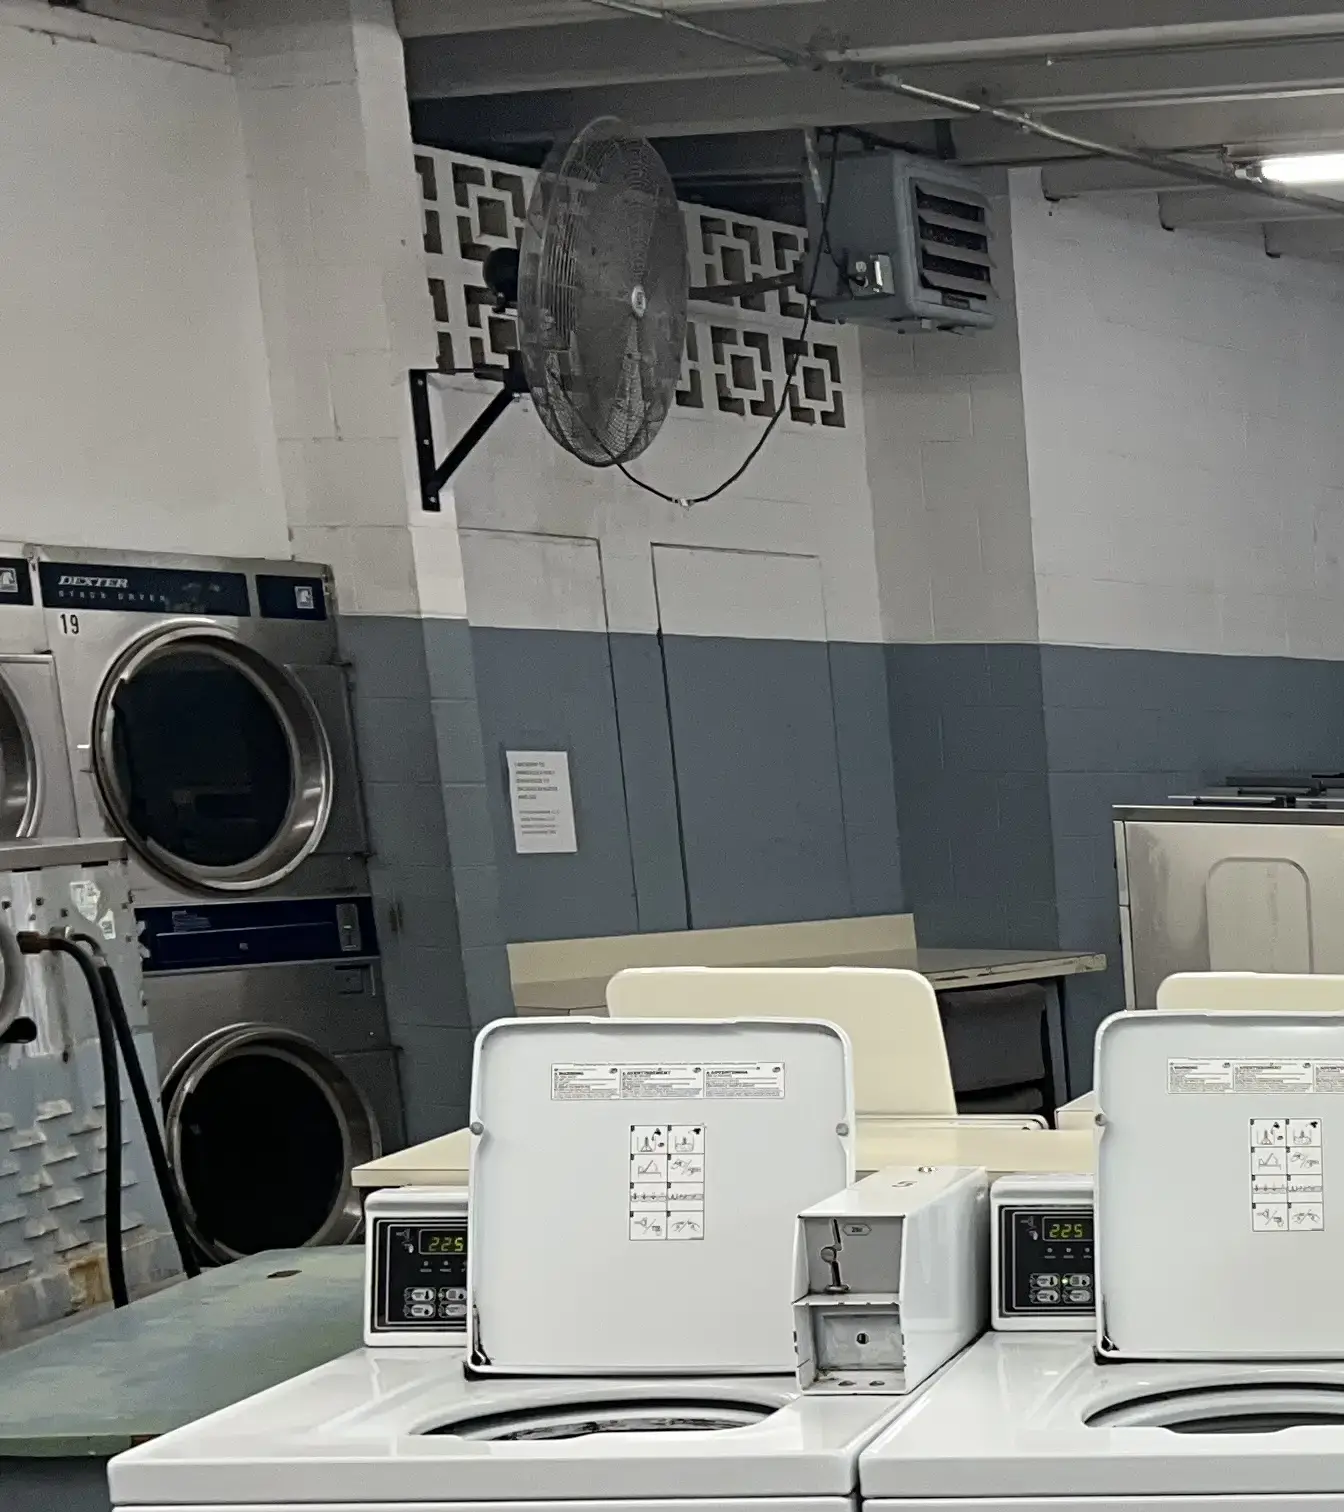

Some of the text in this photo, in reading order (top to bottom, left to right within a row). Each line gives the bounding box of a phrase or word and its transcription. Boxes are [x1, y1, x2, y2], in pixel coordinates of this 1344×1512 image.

[58, 575, 129, 589] DEXTER
[59, 613, 80, 635] 19
[1049, 1223, 1083, 1238] 225
[428, 1236, 465, 1252] 225
